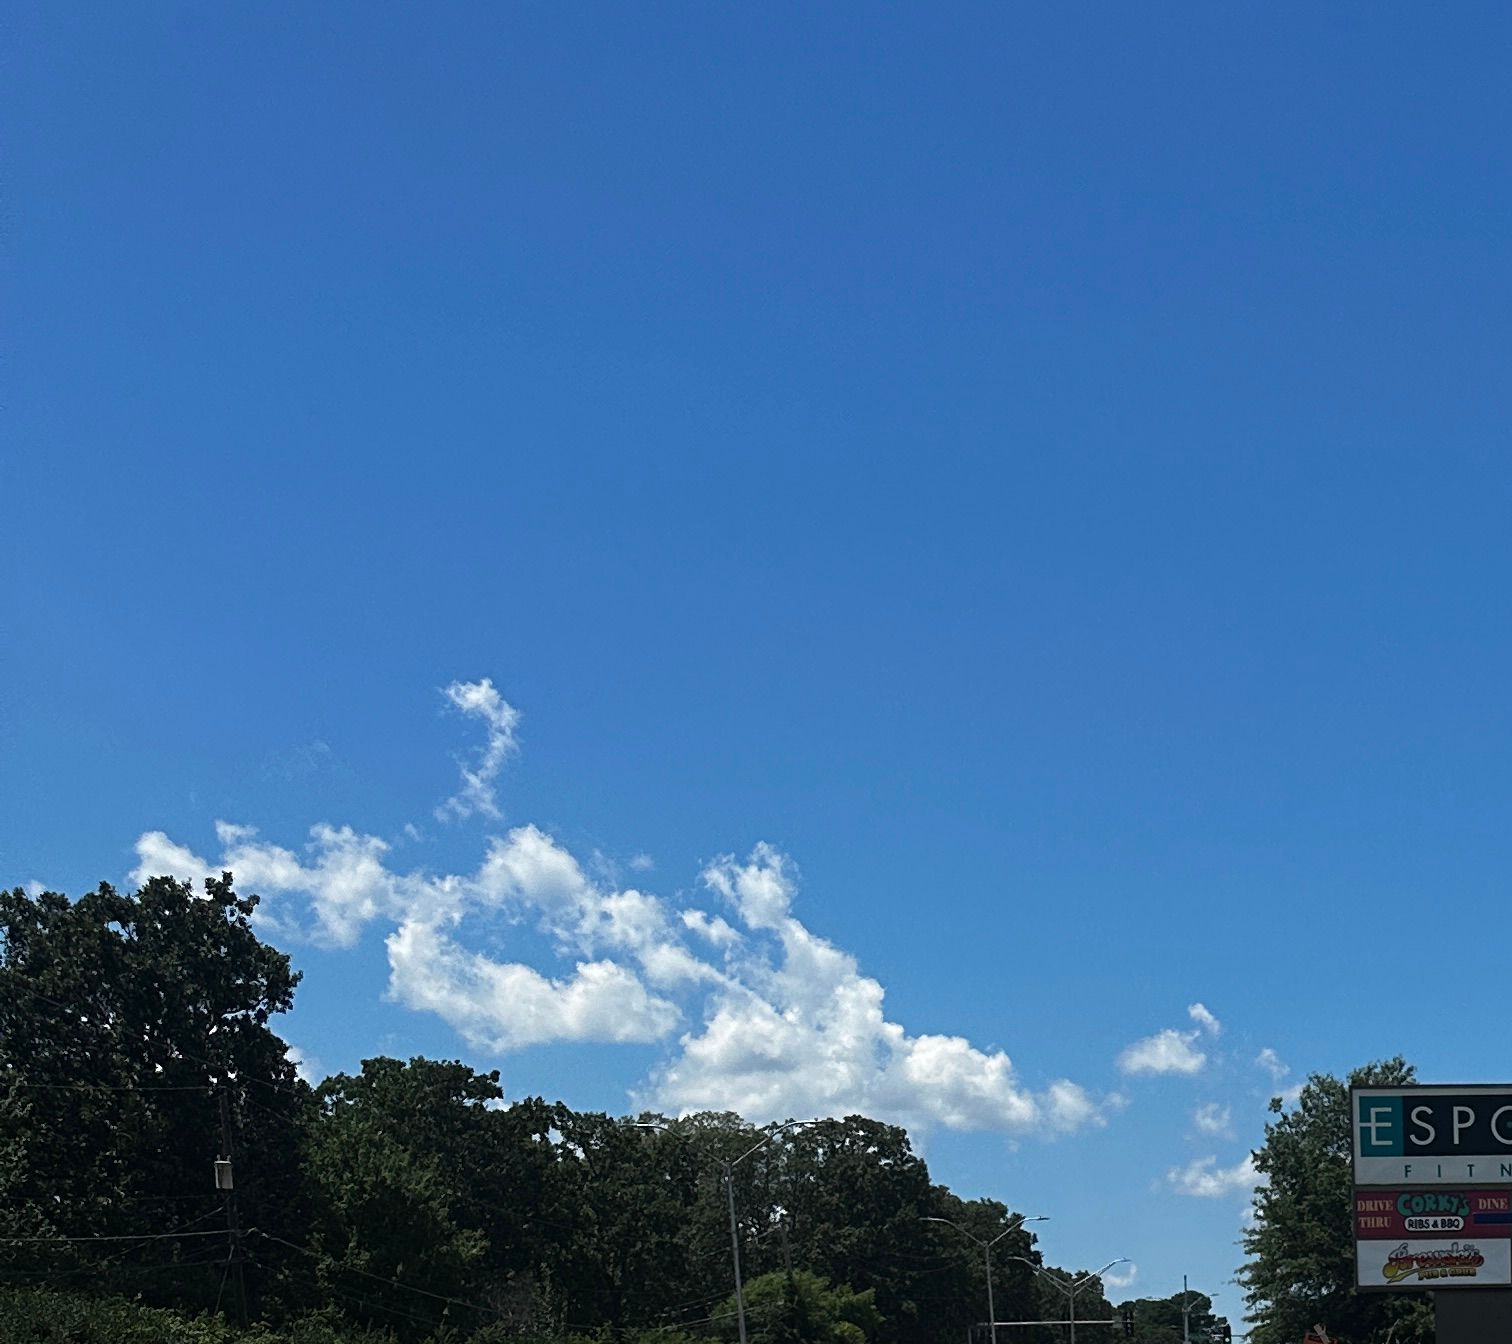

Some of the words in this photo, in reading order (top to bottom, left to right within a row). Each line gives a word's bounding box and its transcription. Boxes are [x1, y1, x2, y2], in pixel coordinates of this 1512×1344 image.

[1357, 1199, 1393, 1212] DRIVE
[1397, 1193, 1471, 1216] CORKY'S
[1478, 1198, 1508, 1210] DINE
[1359, 1217, 1392, 1228] THRU
[1408, 1218, 1430, 1229] RIBS
[1431, 1219, 1439, 1229] &
[1441, 1218, 1460, 1229] BBQ
